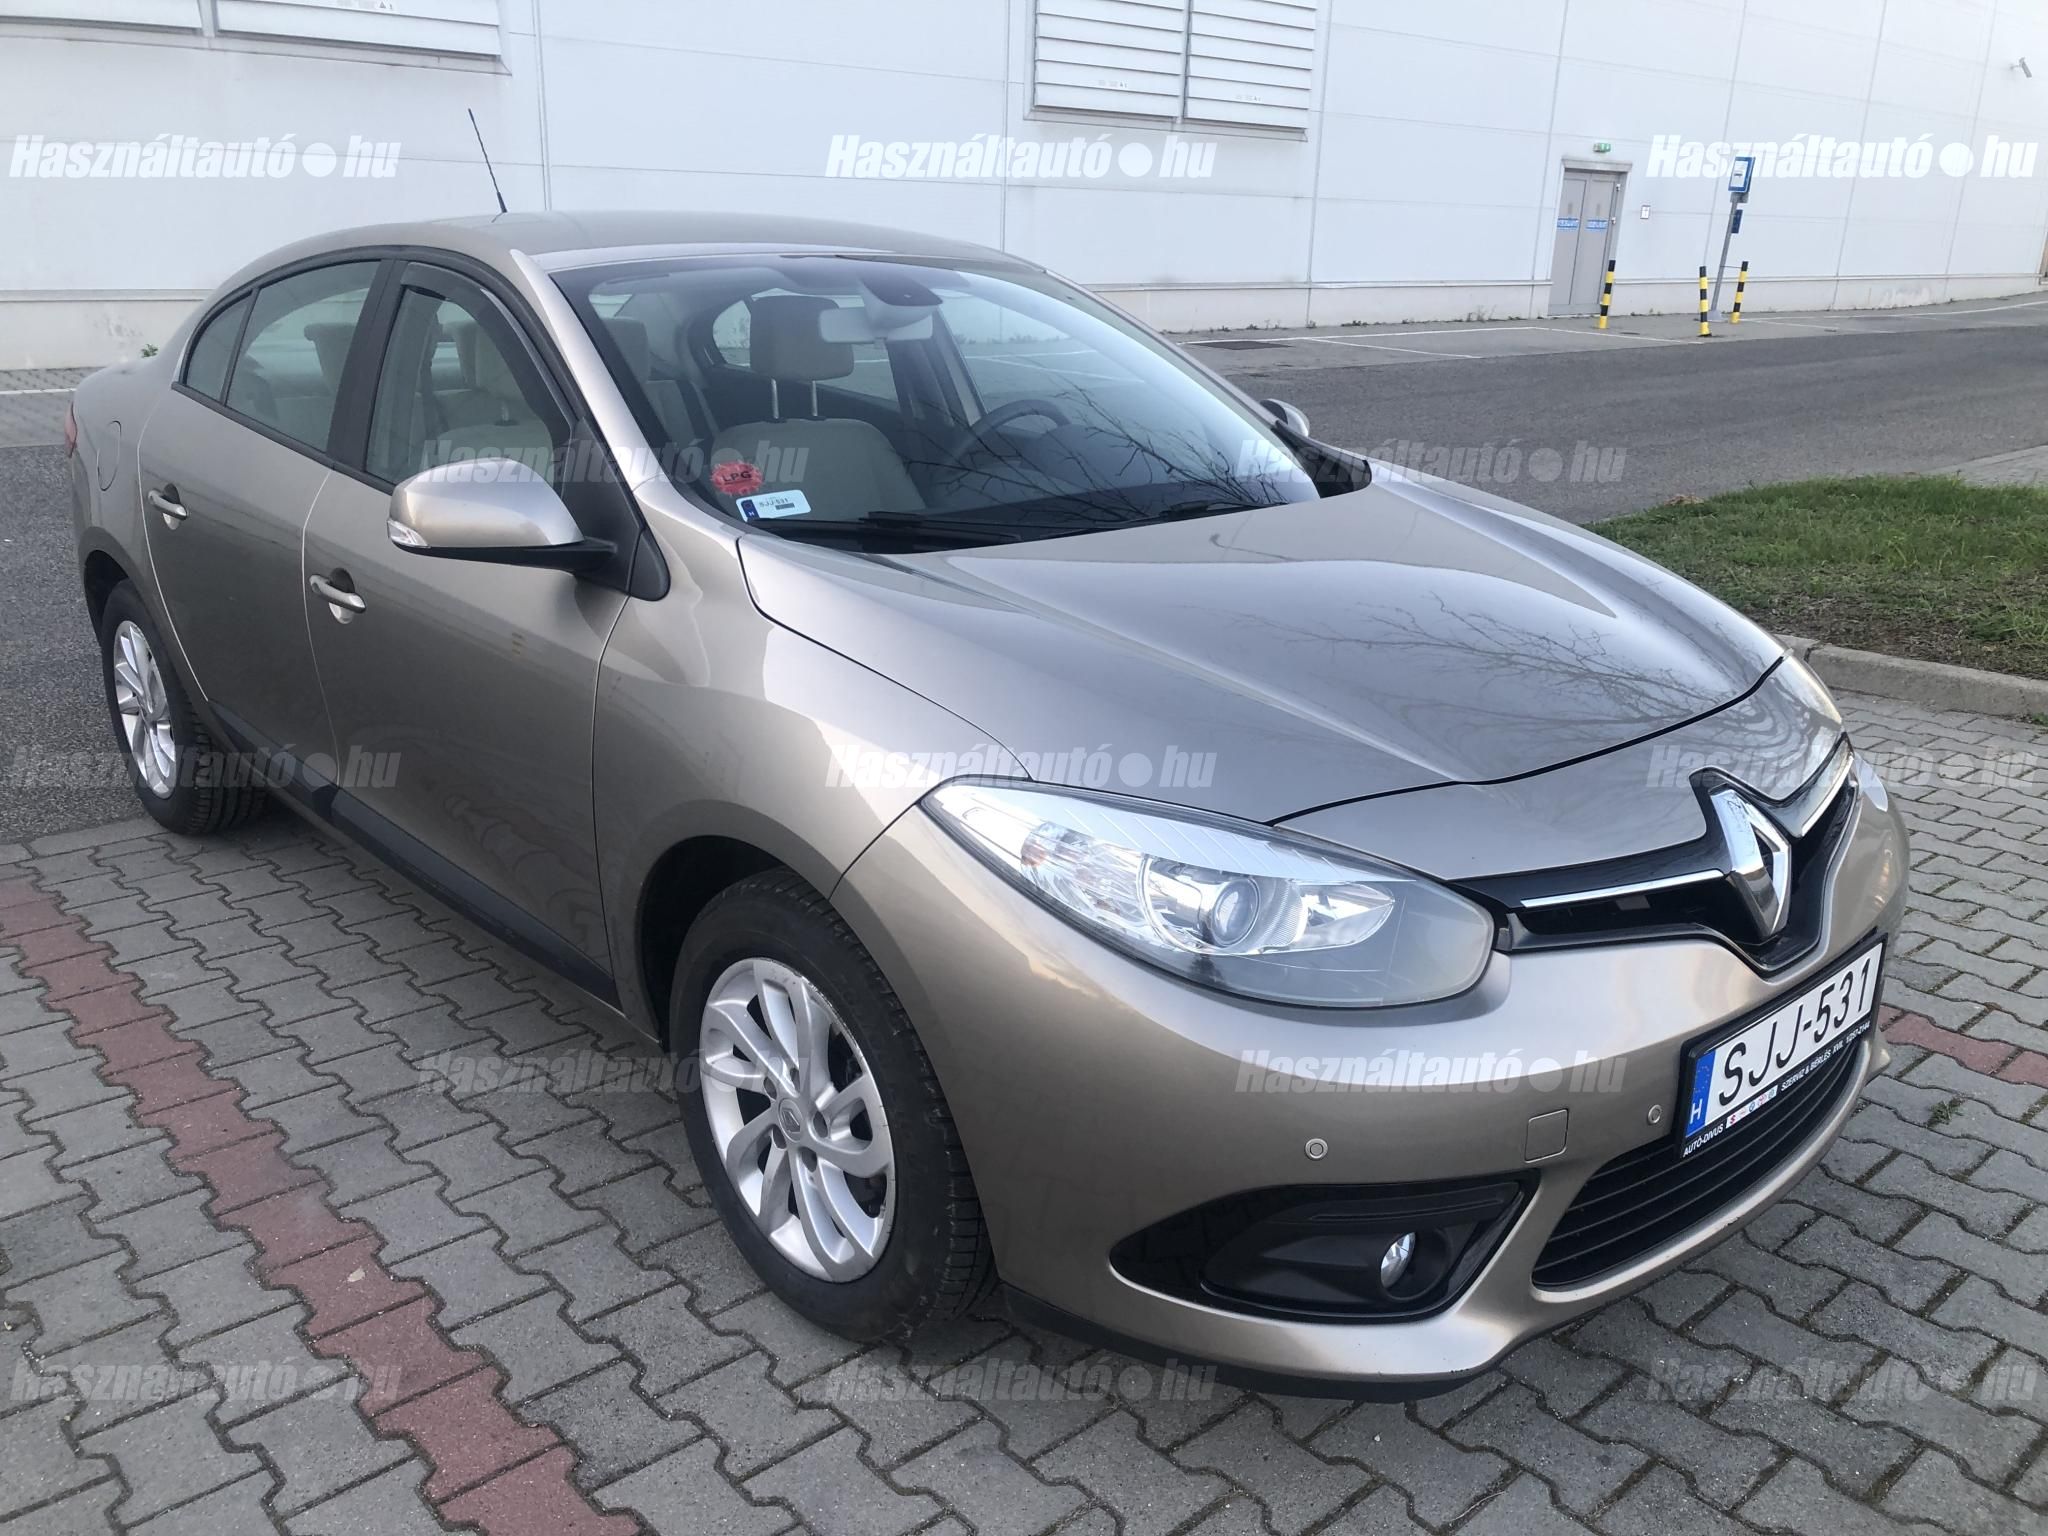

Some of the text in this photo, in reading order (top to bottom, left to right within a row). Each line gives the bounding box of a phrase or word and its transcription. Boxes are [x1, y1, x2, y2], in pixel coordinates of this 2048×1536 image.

[722, 470, 751, 482] LPG
[1718, 957, 1870, 1106] SJJ-531
[1690, 1098, 1703, 1124] H
